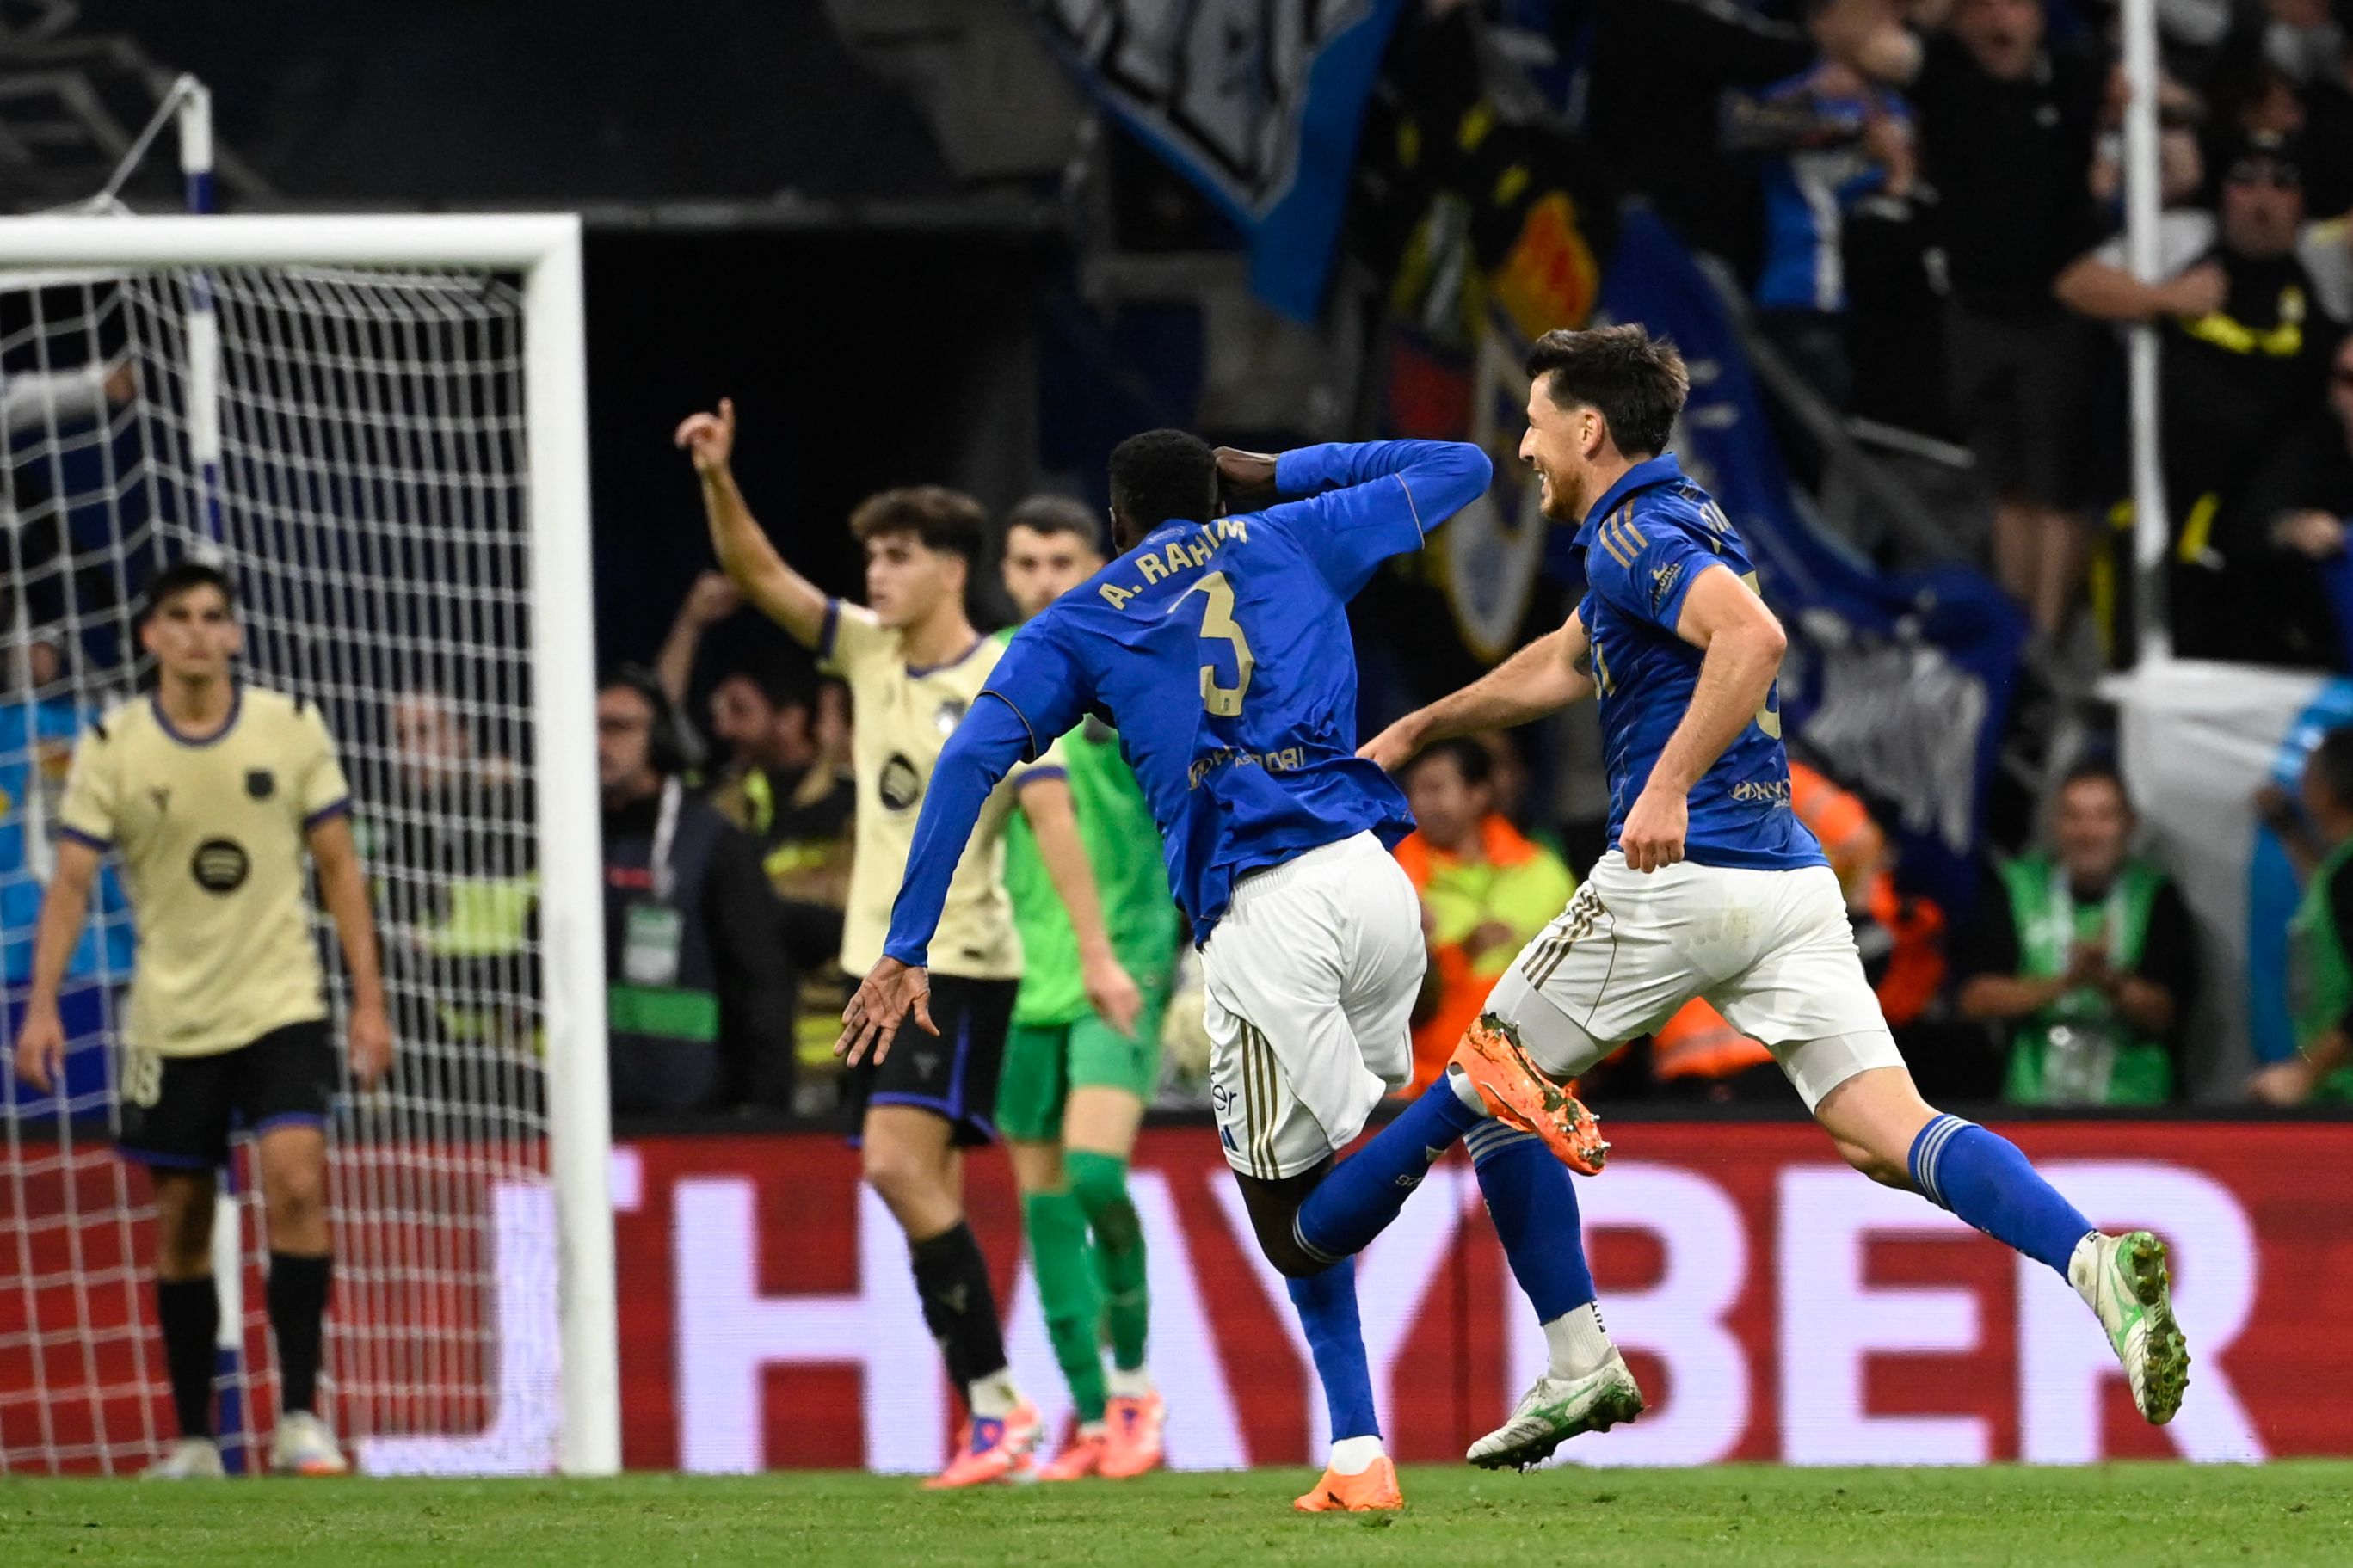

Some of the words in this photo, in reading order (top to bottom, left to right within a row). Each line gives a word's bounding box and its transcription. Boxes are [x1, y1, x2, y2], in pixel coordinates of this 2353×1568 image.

[1098, 582, 1143, 611] A.
[1135, 520, 1248, 586] RAHIM
[1166, 570, 1255, 716] 3
